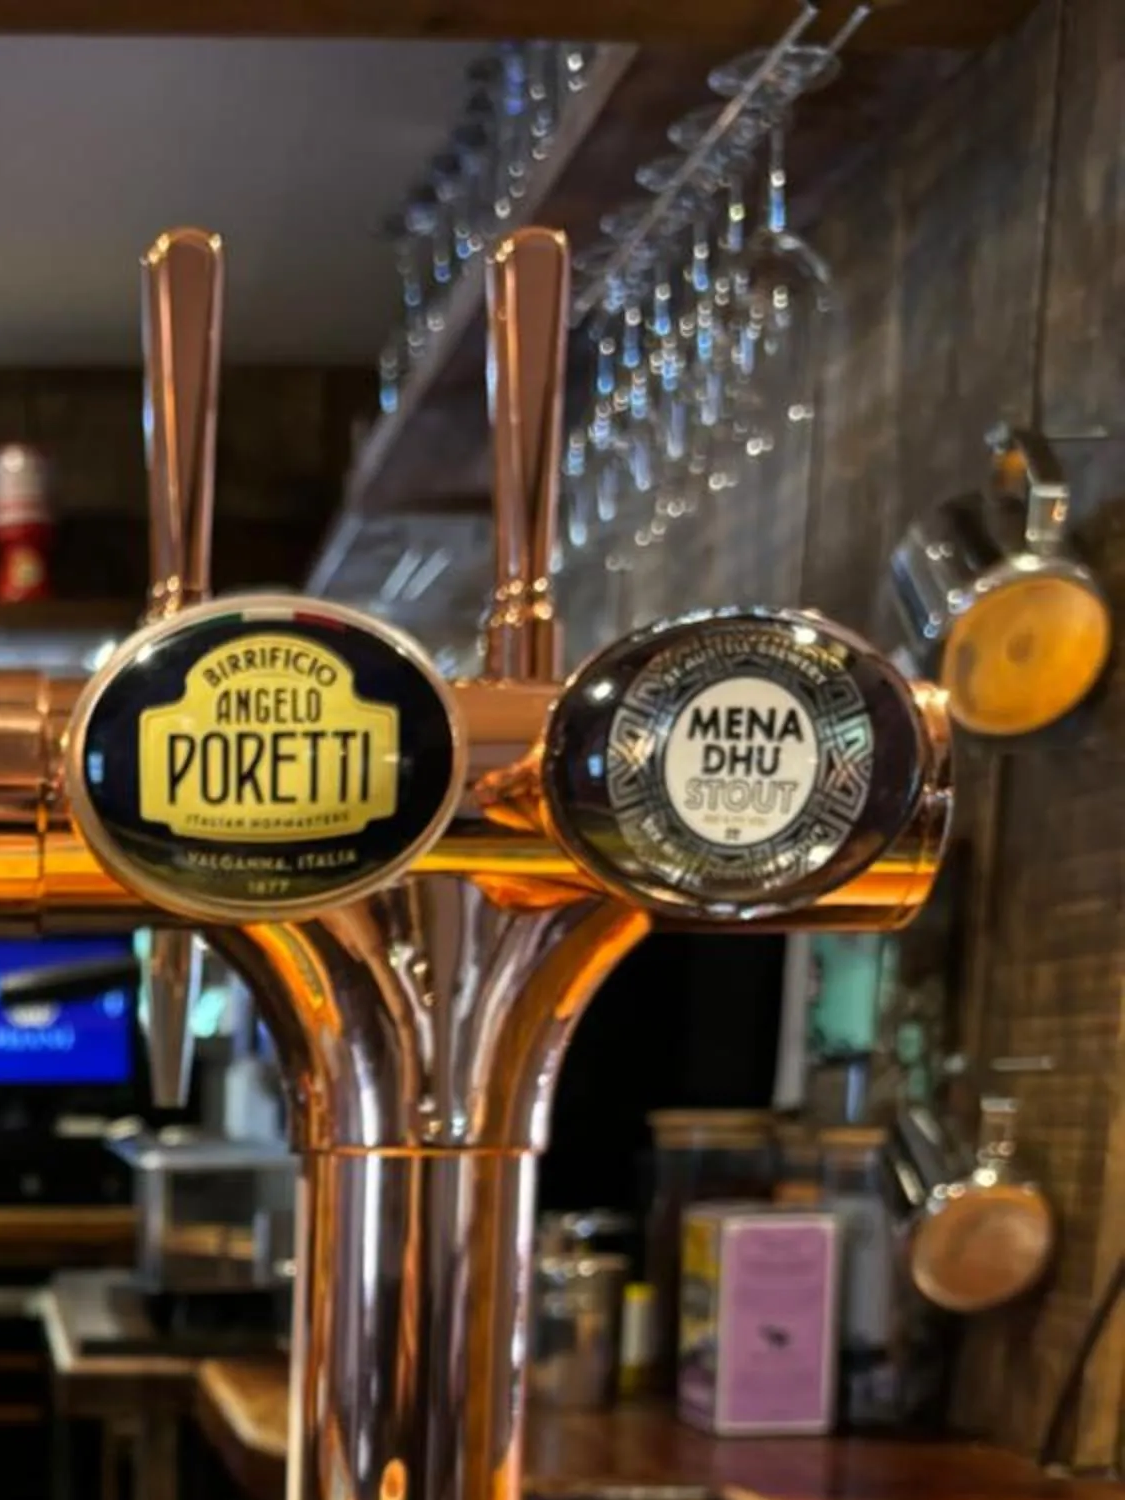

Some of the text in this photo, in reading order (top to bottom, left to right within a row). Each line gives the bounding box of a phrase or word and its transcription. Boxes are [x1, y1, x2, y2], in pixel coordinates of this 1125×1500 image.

[203, 646, 338, 687] BIRRIFICIO
[216, 688, 322, 725] ANGELO
[687, 706, 804, 742] MENA
[167, 731, 372, 806] PORETTI
[701, 744, 782, 775] DHU
[683, 778, 800, 815] STOUT
[298, 849, 357, 869] ITALIA
